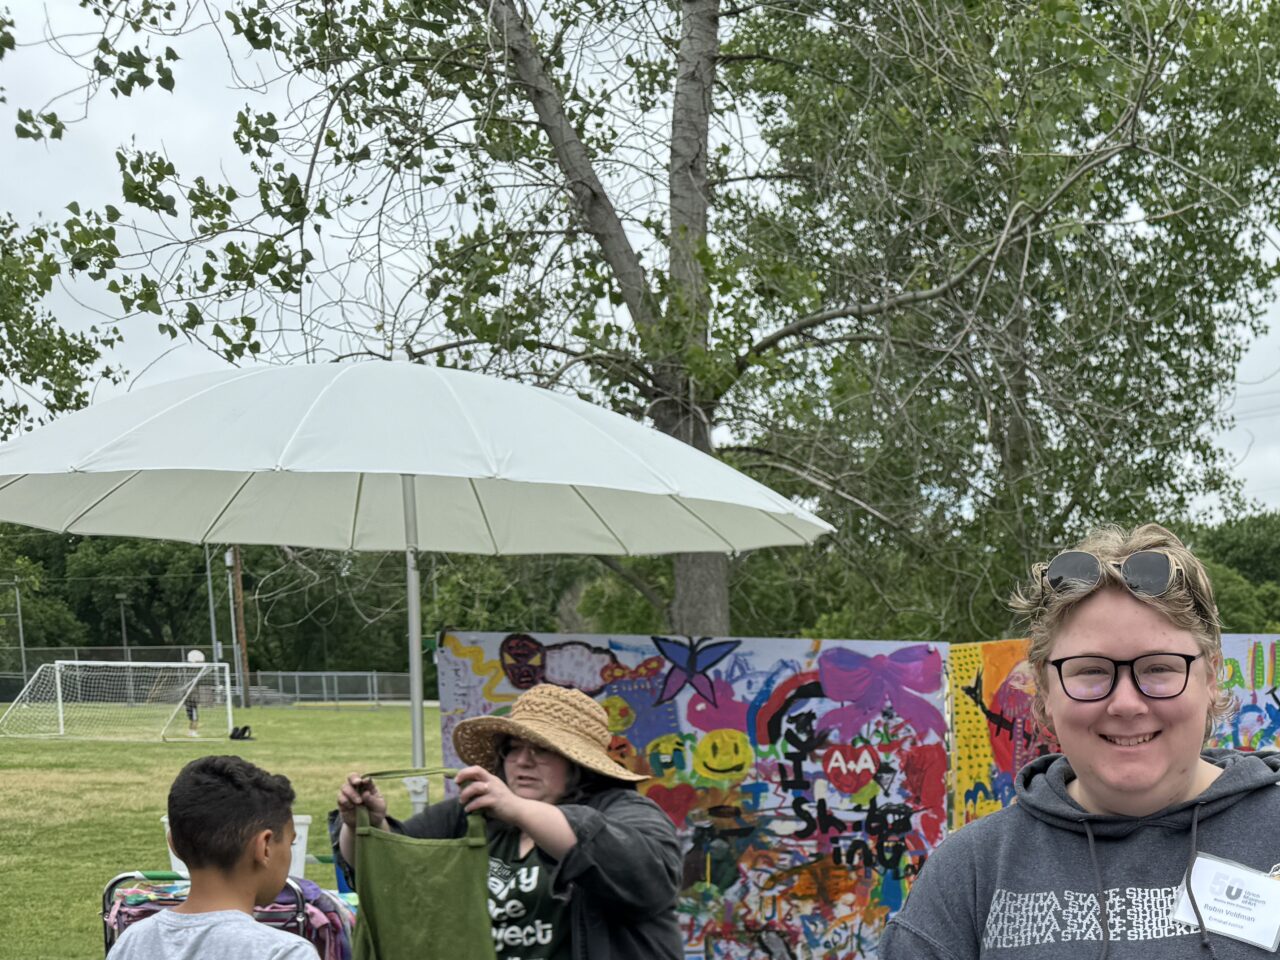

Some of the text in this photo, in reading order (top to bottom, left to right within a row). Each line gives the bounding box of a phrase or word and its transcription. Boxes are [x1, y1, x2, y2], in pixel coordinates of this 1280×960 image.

[1204, 903, 1224, 914] Robin
[1225, 908, 1255, 923] Veldman
[491, 919, 553, 952] ject
